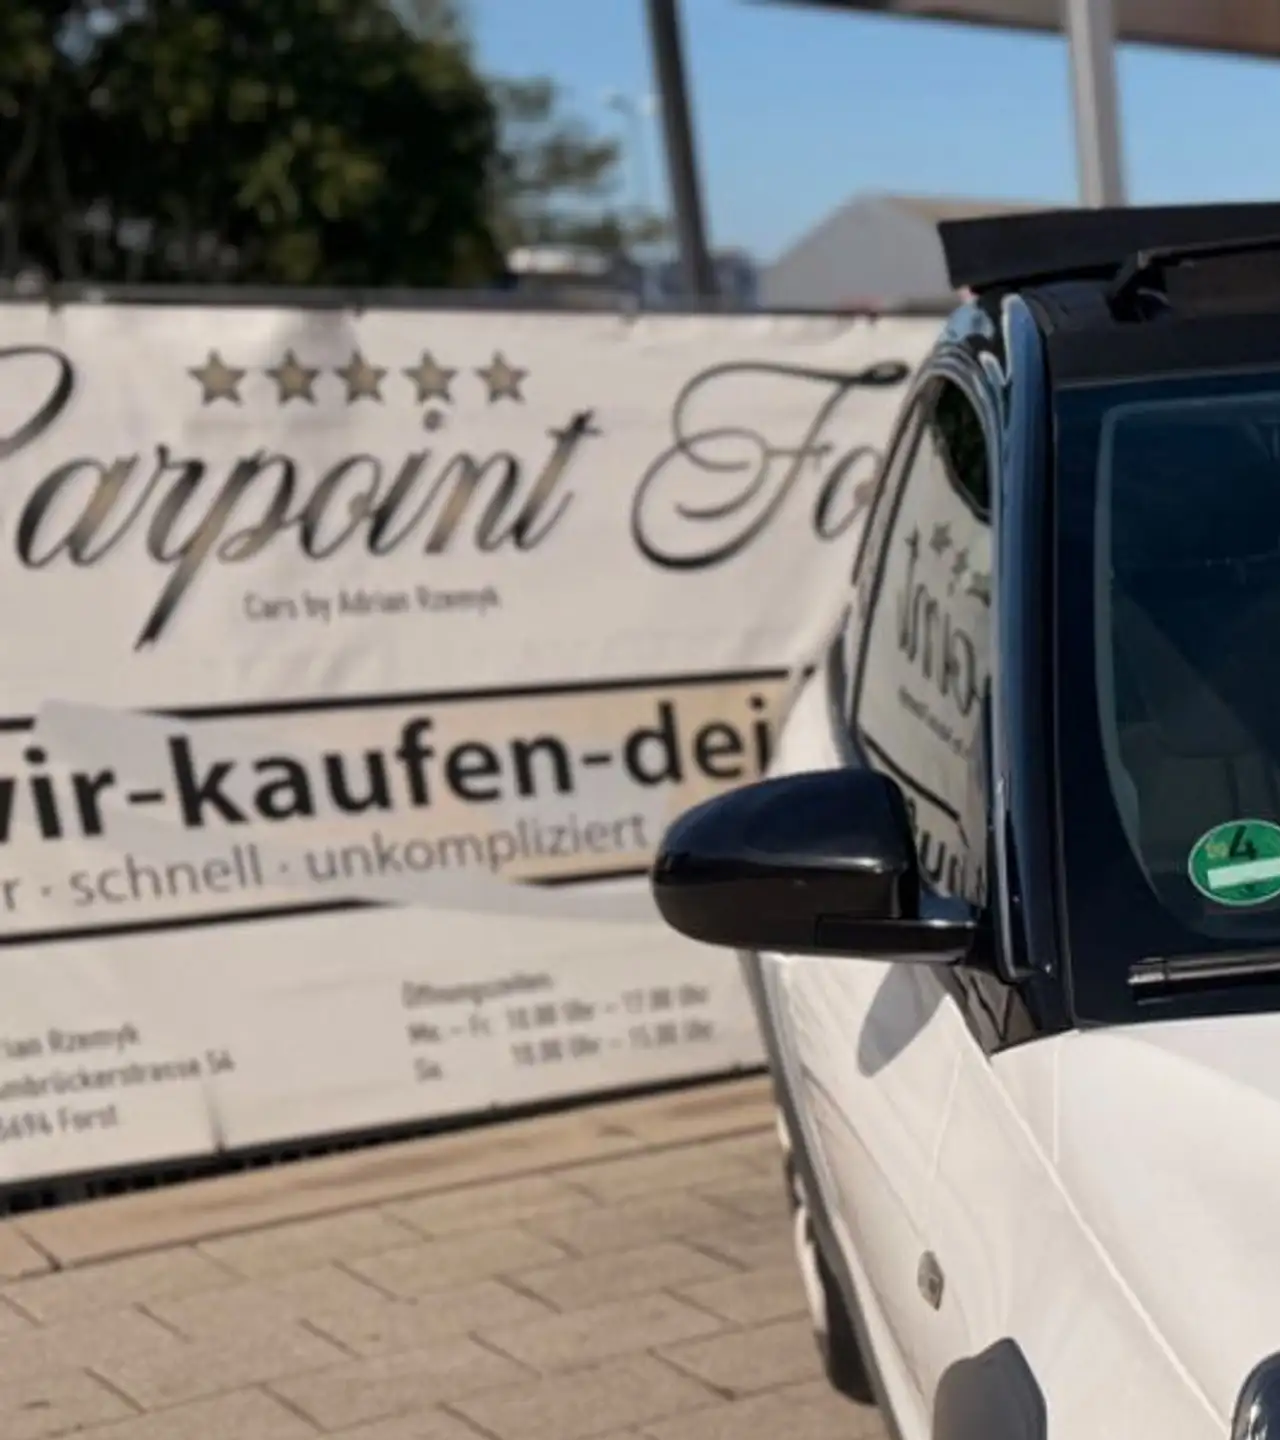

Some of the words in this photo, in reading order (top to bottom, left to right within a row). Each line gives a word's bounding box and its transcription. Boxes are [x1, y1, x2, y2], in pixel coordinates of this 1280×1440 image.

[0, 346, 603, 652] arpoint
[0, 694, 772, 844] ir-kaufen-dei
[68, 842, 264, 907] schnell
[305, 812, 648, 885] unkompliziert
